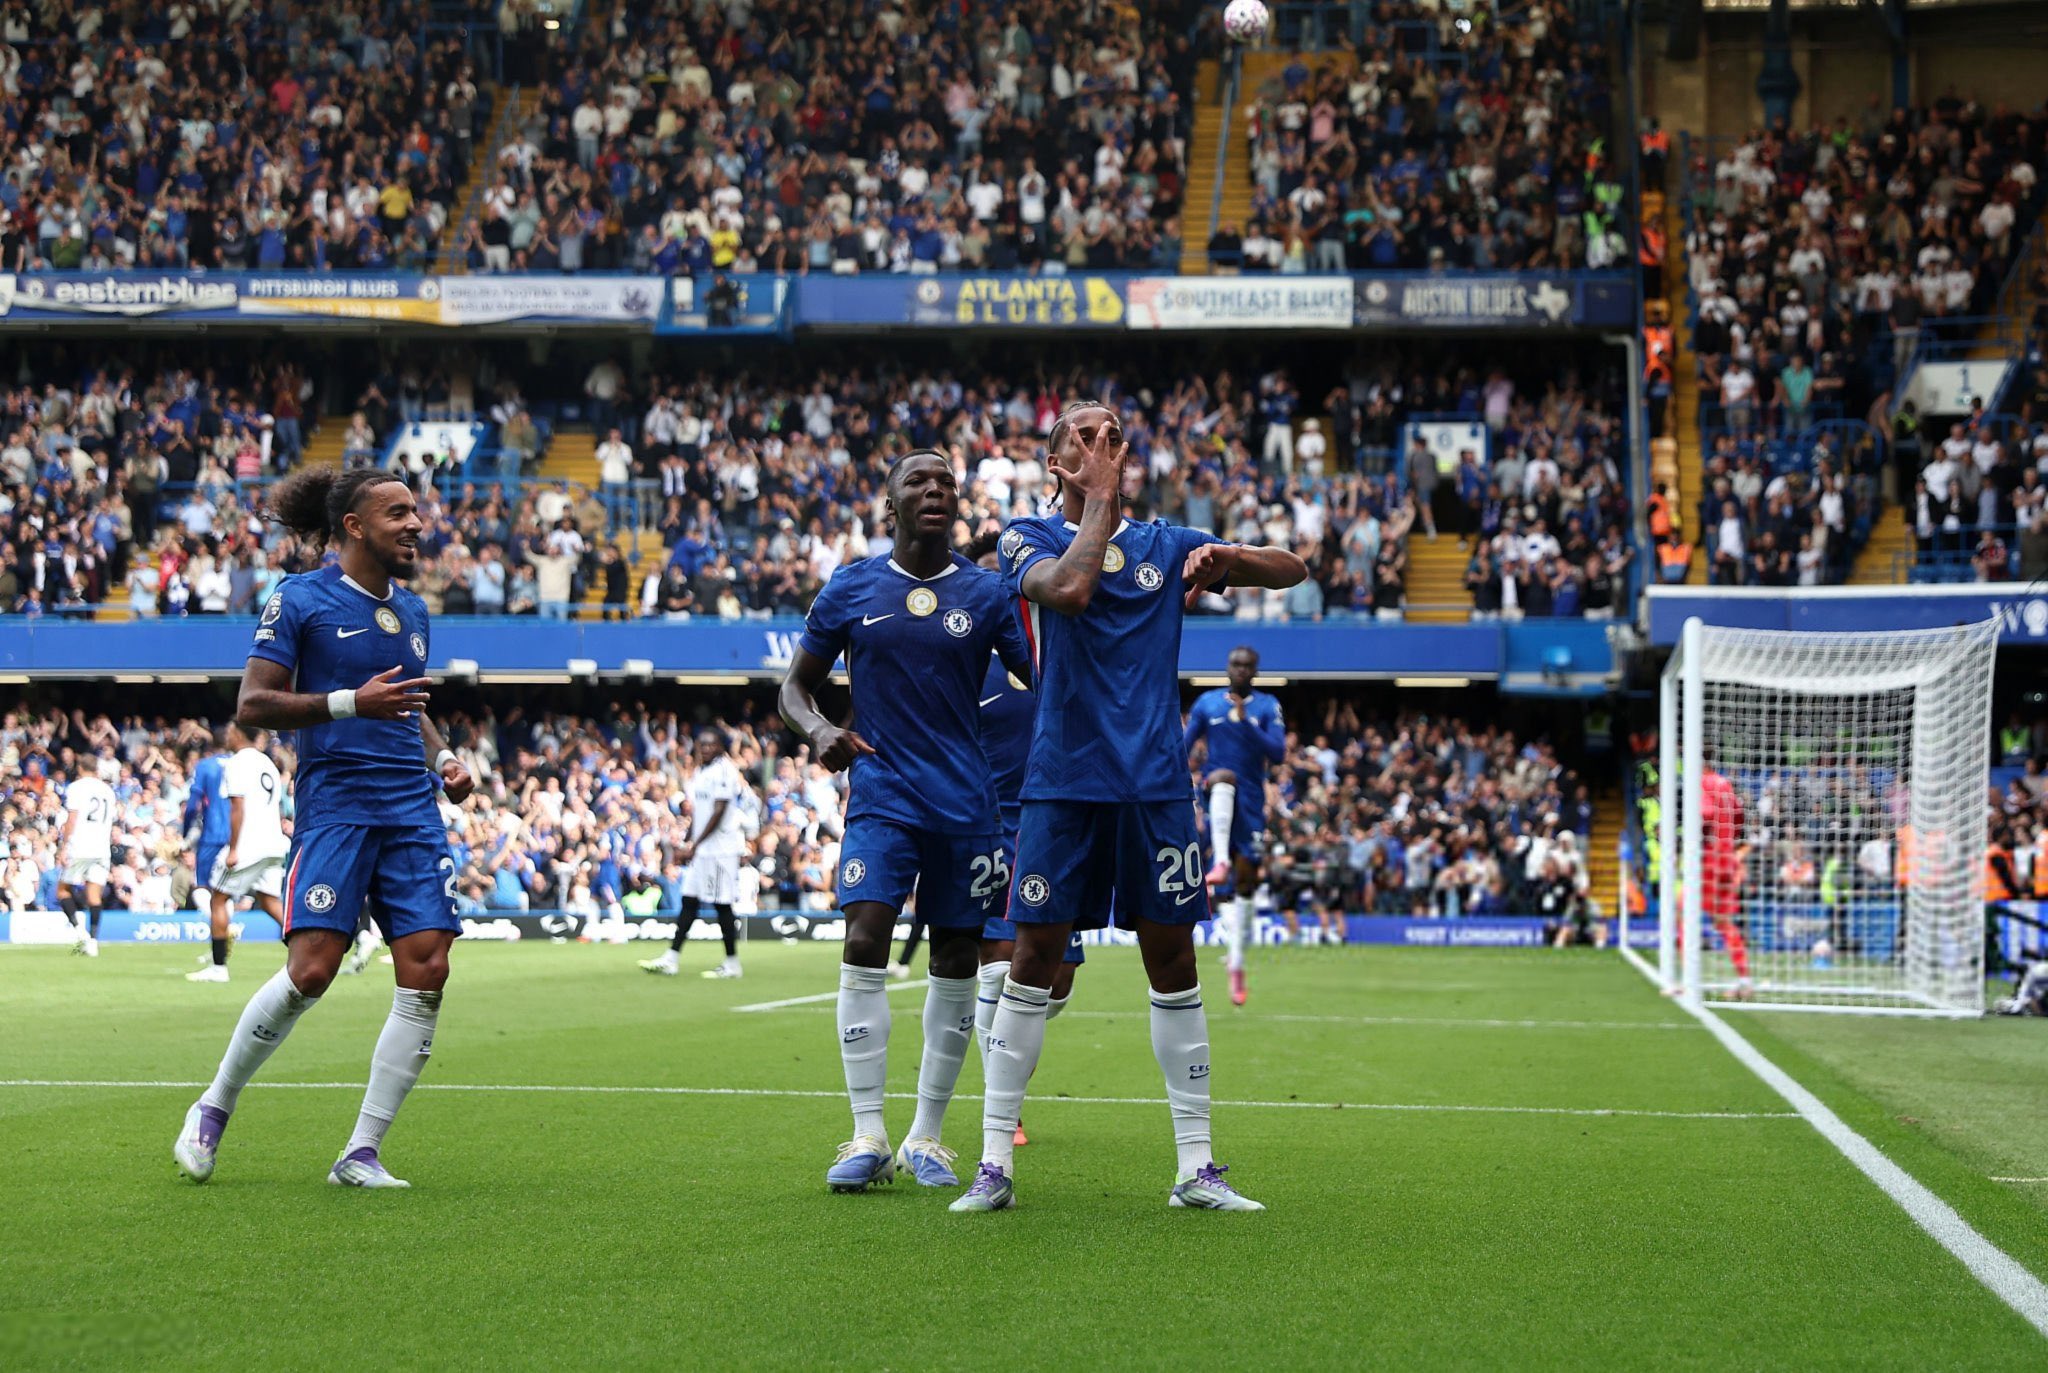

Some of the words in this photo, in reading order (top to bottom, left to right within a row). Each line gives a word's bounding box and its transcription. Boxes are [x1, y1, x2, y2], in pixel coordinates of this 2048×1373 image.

[55, 276, 238, 304] easternblues
[251, 279, 347, 298] PITTSBURGH
[352, 279, 399, 298] BLUES
[960, 278, 1077, 302] ATLANTA
[1163, 287, 1283, 310] SOUTHEAST
[1288, 287, 1350, 309] BLUES
[1402, 286, 1467, 316] AUSTIN
[1470, 285, 1529, 316] BLUES
[955, 299, 1078, 324] BLUES
[1961, 367, 1971, 392] 1
[260, 771, 276, 806] 9
[86, 796, 108, 823] 21
[969, 847, 1010, 898] 25
[1157, 842, 1202, 893] 20
[133, 921, 180, 941] JOIN
